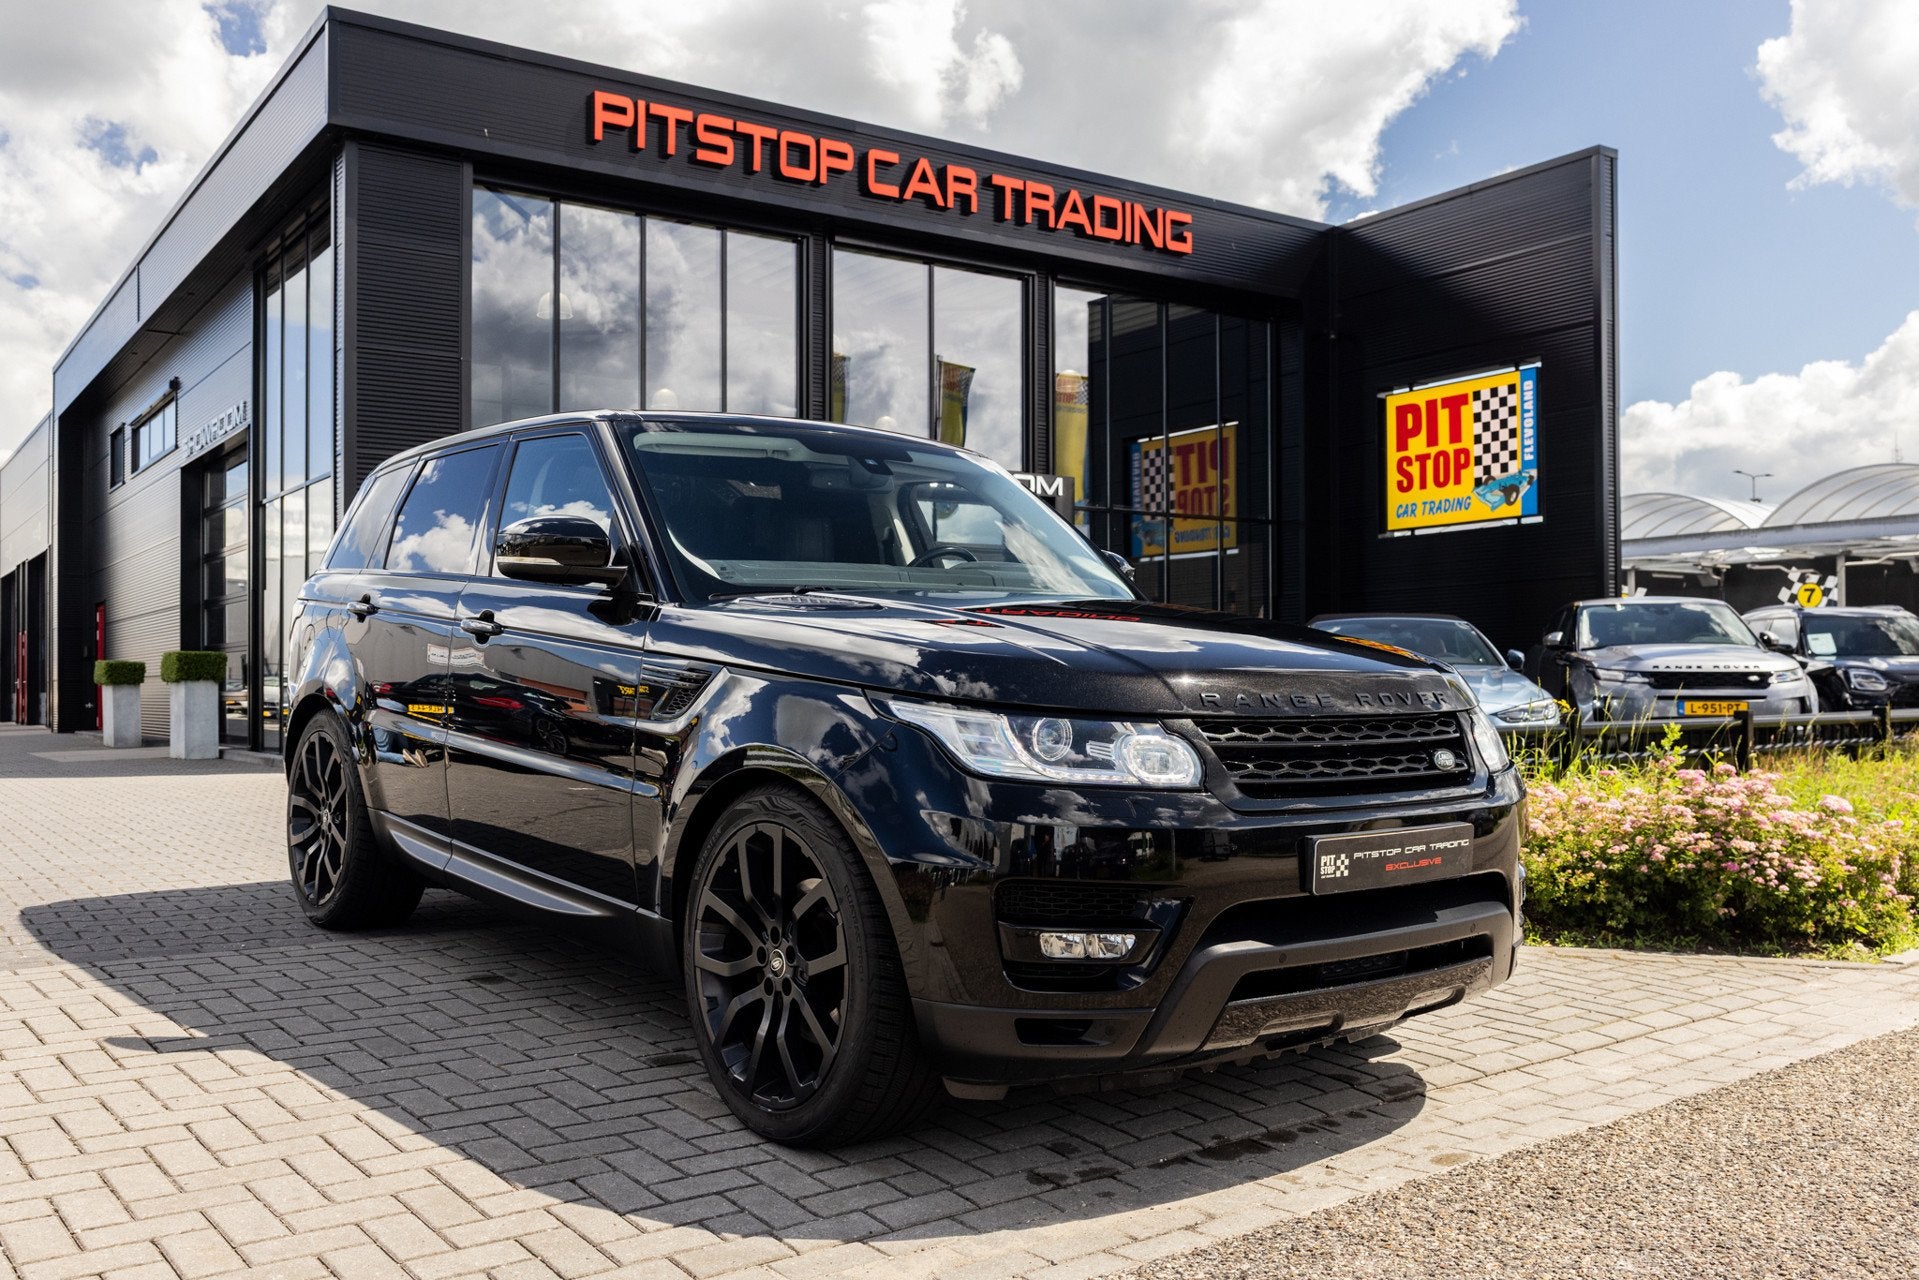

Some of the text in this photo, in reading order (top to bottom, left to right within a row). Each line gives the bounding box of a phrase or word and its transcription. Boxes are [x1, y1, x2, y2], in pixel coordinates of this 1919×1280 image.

[594, 90, 1194, 255] PITSTOP CAR TRADING
[1395, 393, 1469, 453] PIT
[1523, 380, 1534, 461] FLEVOLAND
[1396, 447, 1471, 493] STOP
[1396, 495, 1472, 519] CAR TRADING
[1804, 588, 1816, 603] 7
[1200, 690, 1448, 708] RANGE ROVER
[1690, 703, 1741, 714] L-951-PT
[1353, 838, 1470, 860] PITSTOP CAR TRADING
[1320, 854, 1336, 866] PIT
[1320, 865, 1336, 875] STOP
[1385, 856, 1442, 871] EXCLUSIVE
